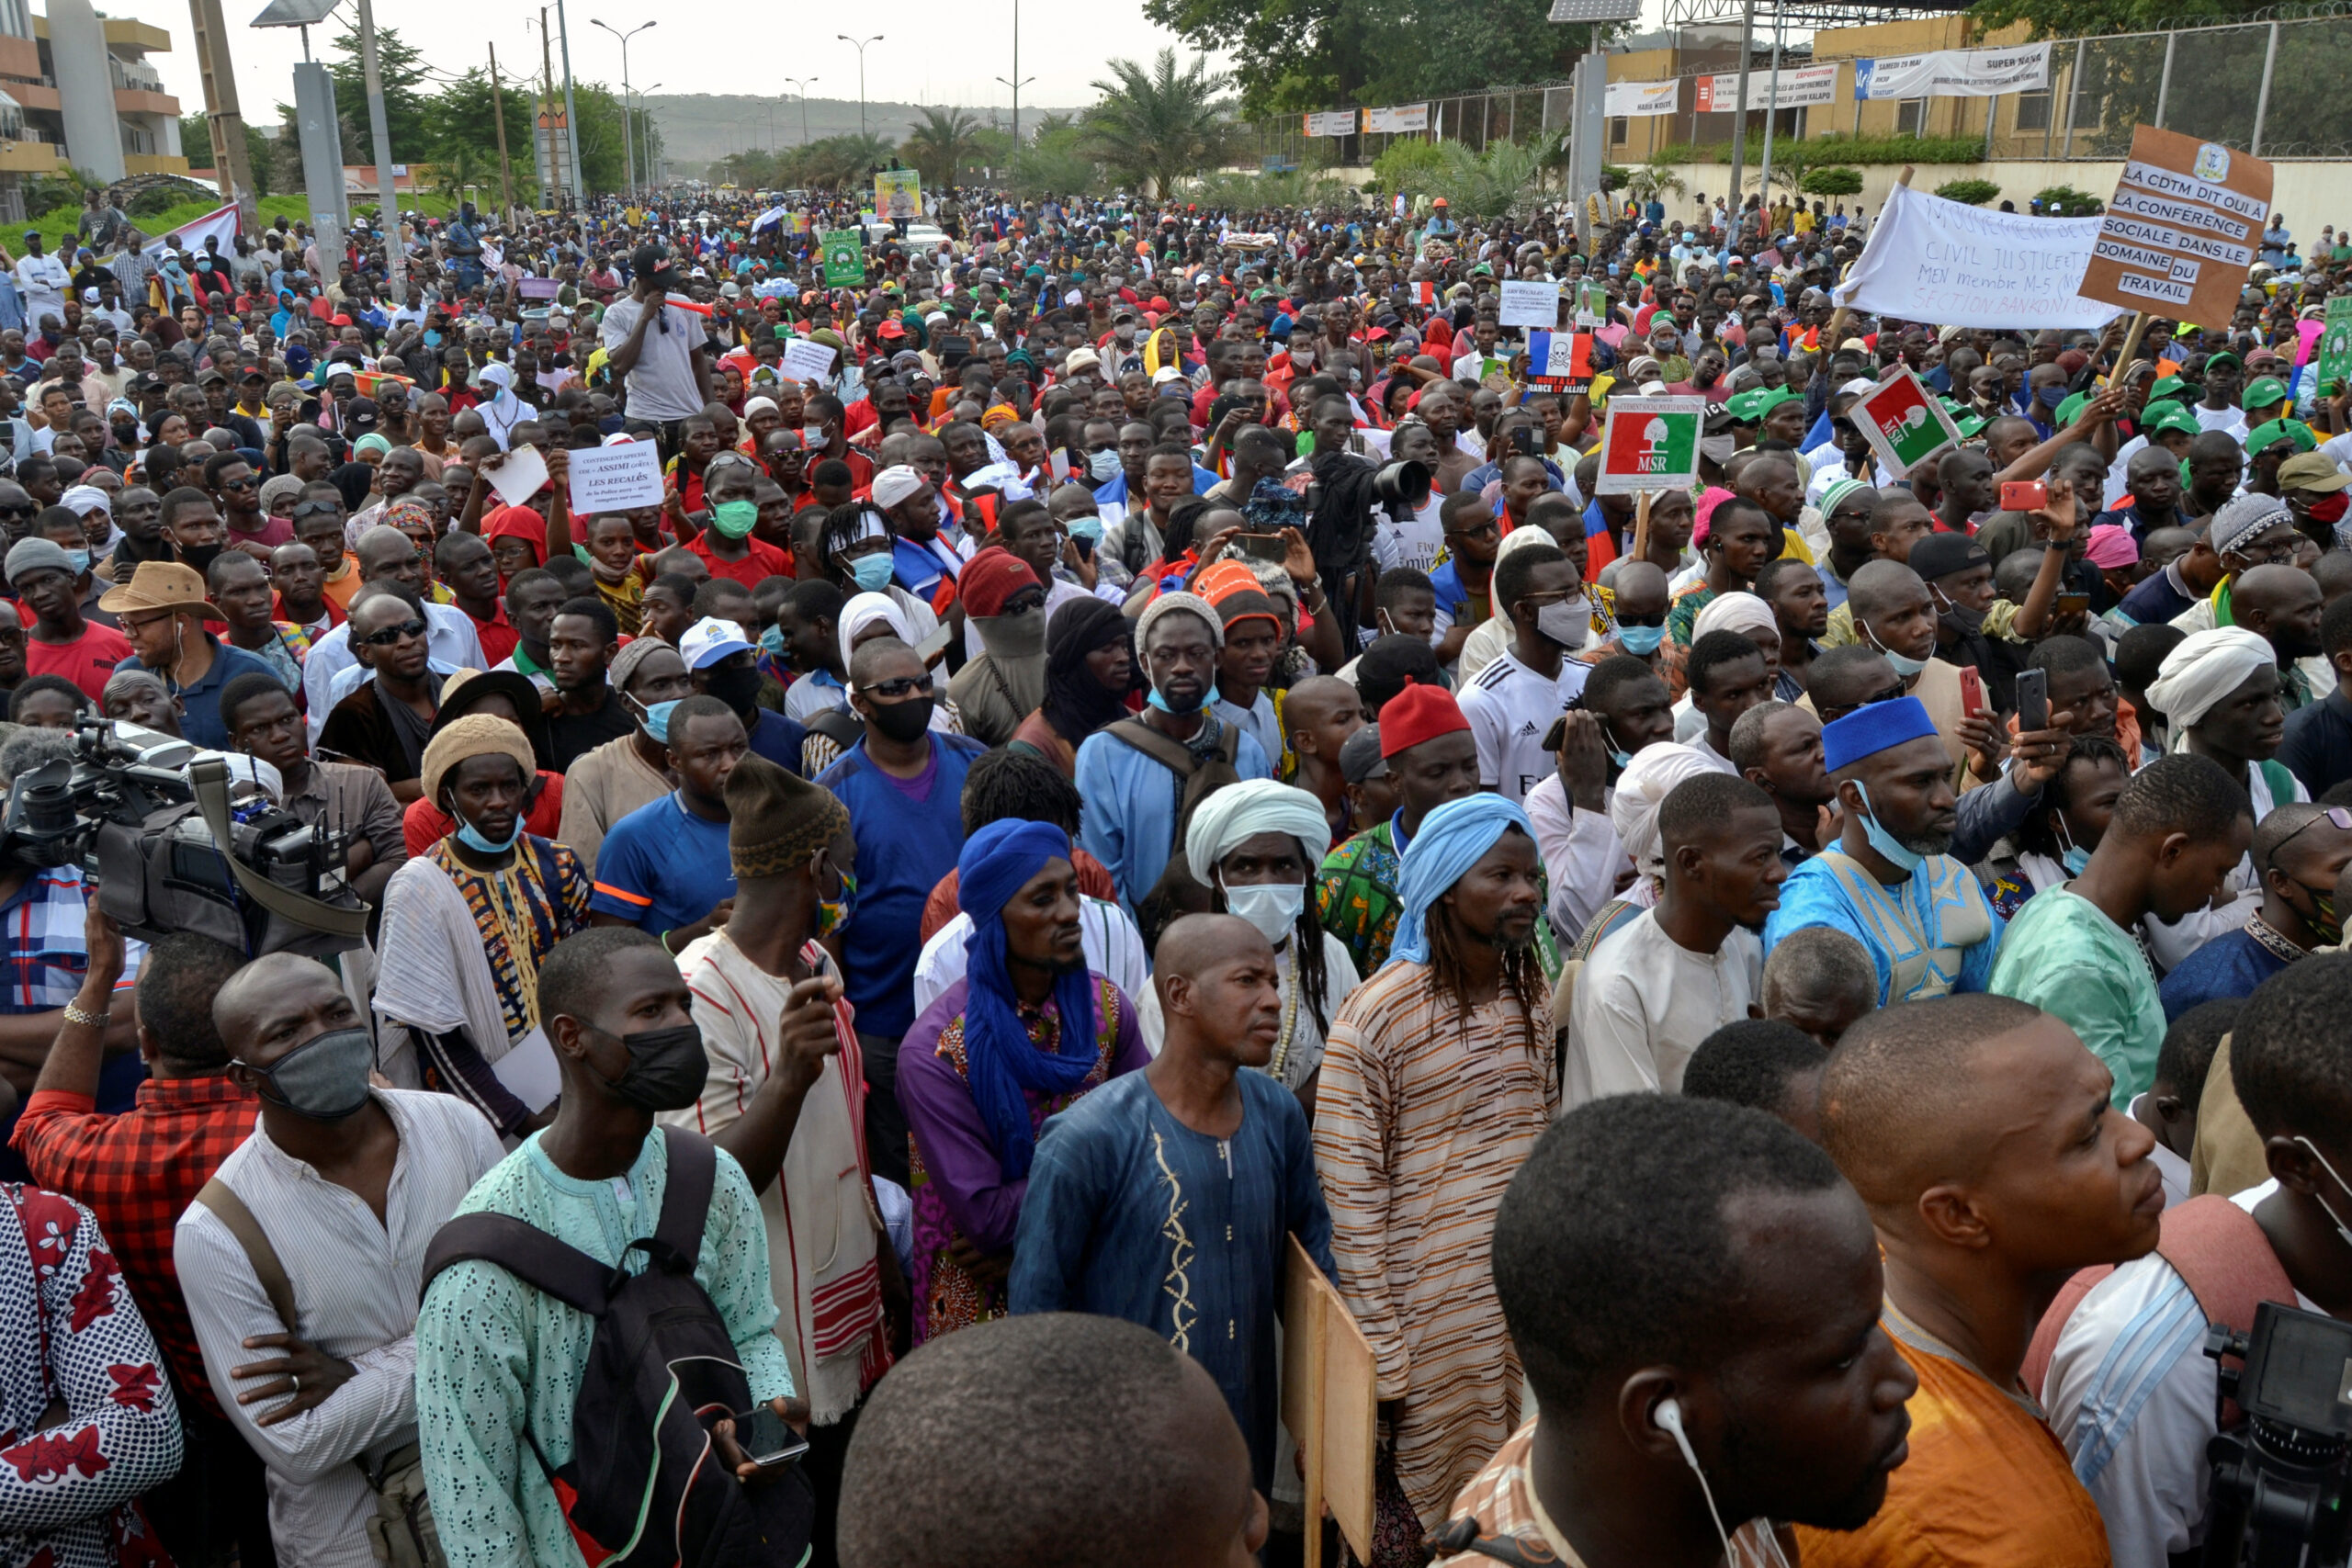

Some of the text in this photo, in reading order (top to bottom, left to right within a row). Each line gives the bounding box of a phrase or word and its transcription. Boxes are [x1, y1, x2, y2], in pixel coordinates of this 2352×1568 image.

[1986, 53, 2041, 69] SUPER NANA
[1795, 68, 1834, 79] EXPOSITION
[1795, 79, 1832, 90] CONFINEMENT
[1808, 92, 1830, 101] KALAPO
[2123, 167, 2261, 219] LA CDTM DIT OUI À
[1928, 198, 2051, 240] MOUVEMENT
[2113, 194, 2245, 238] LA CONFÉRENCE
[2103, 219, 2245, 263] SOCIALE DANS LE
[1926, 242, 1981, 265] CIVIL
[2096, 242, 2172, 268] DOMAINE
[2172, 265, 2196, 279] DU
[1918, 265, 1949, 284] MEN
[2024, 276, 2051, 294] M-5
[2121, 275, 2186, 299] TRAVAIL
[1913, 288, 1994, 314] SECTION
[1554, 385, 1563, 393] ET
[1563, 384, 1588, 394] ALLIÉS
[1566, 378, 1576, 386] LA
[1881, 419, 1905, 447] MSR
[582, 456, 622, 464] CONTINGENT
[597, 463, 629, 473] ASSIMI
[1637, 456, 1667, 471] MSR
[1417, 542, 1434, 553] Fly
[1521, 728, 1540, 737] adidas
